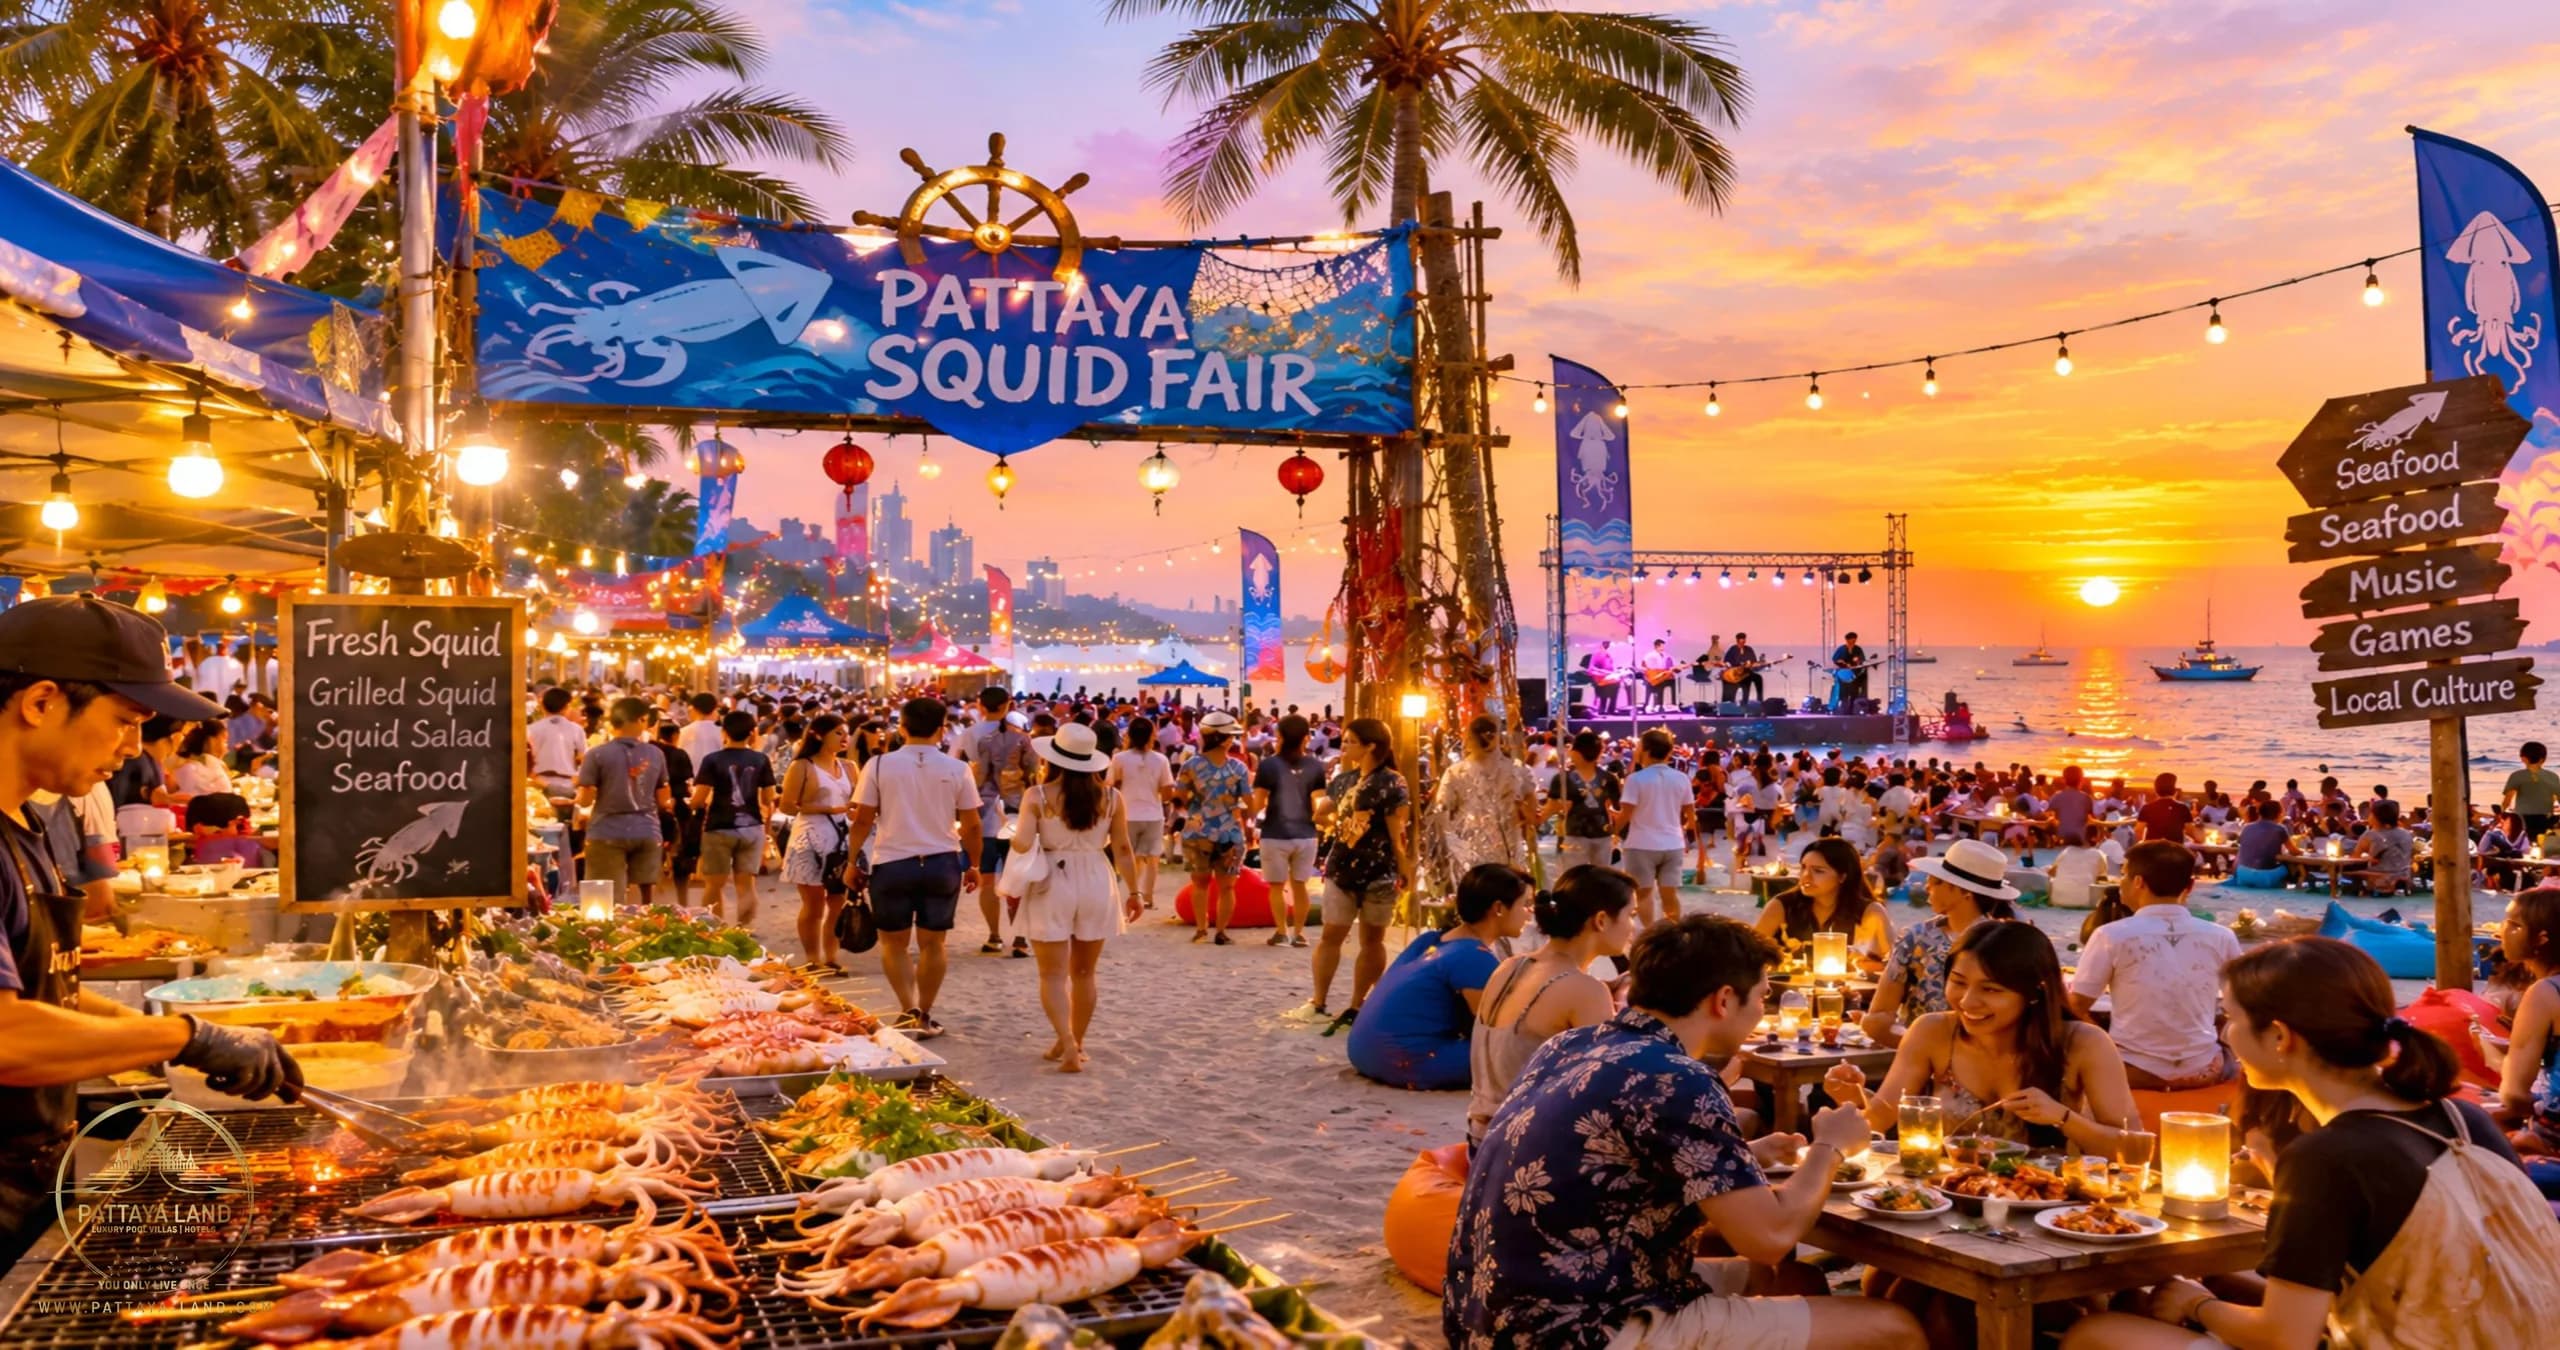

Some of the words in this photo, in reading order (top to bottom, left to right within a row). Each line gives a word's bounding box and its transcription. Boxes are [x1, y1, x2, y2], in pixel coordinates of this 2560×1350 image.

[876, 268, 1189, 341] PATTAYA
[864, 333, 1130, 410] SQUID
[1148, 347, 1322, 417] FAIR
[2336, 440, 2460, 490] Seafood
[2319, 492, 2463, 548] Seafood
[2348, 559, 2457, 603] Music
[306, 619, 399, 658] Fresh
[409, 620, 502, 669] Squid
[2349, 619, 2473, 657] Games
[308, 676, 406, 706] Grilled
[417, 676, 497, 716] Squid
[2330, 680, 2402, 716] Local
[2411, 674, 2517, 708] Culture
[314, 718, 400, 758] Squid
[410, 718, 492, 749] Salad
[330, 759, 468, 793] Seafood
